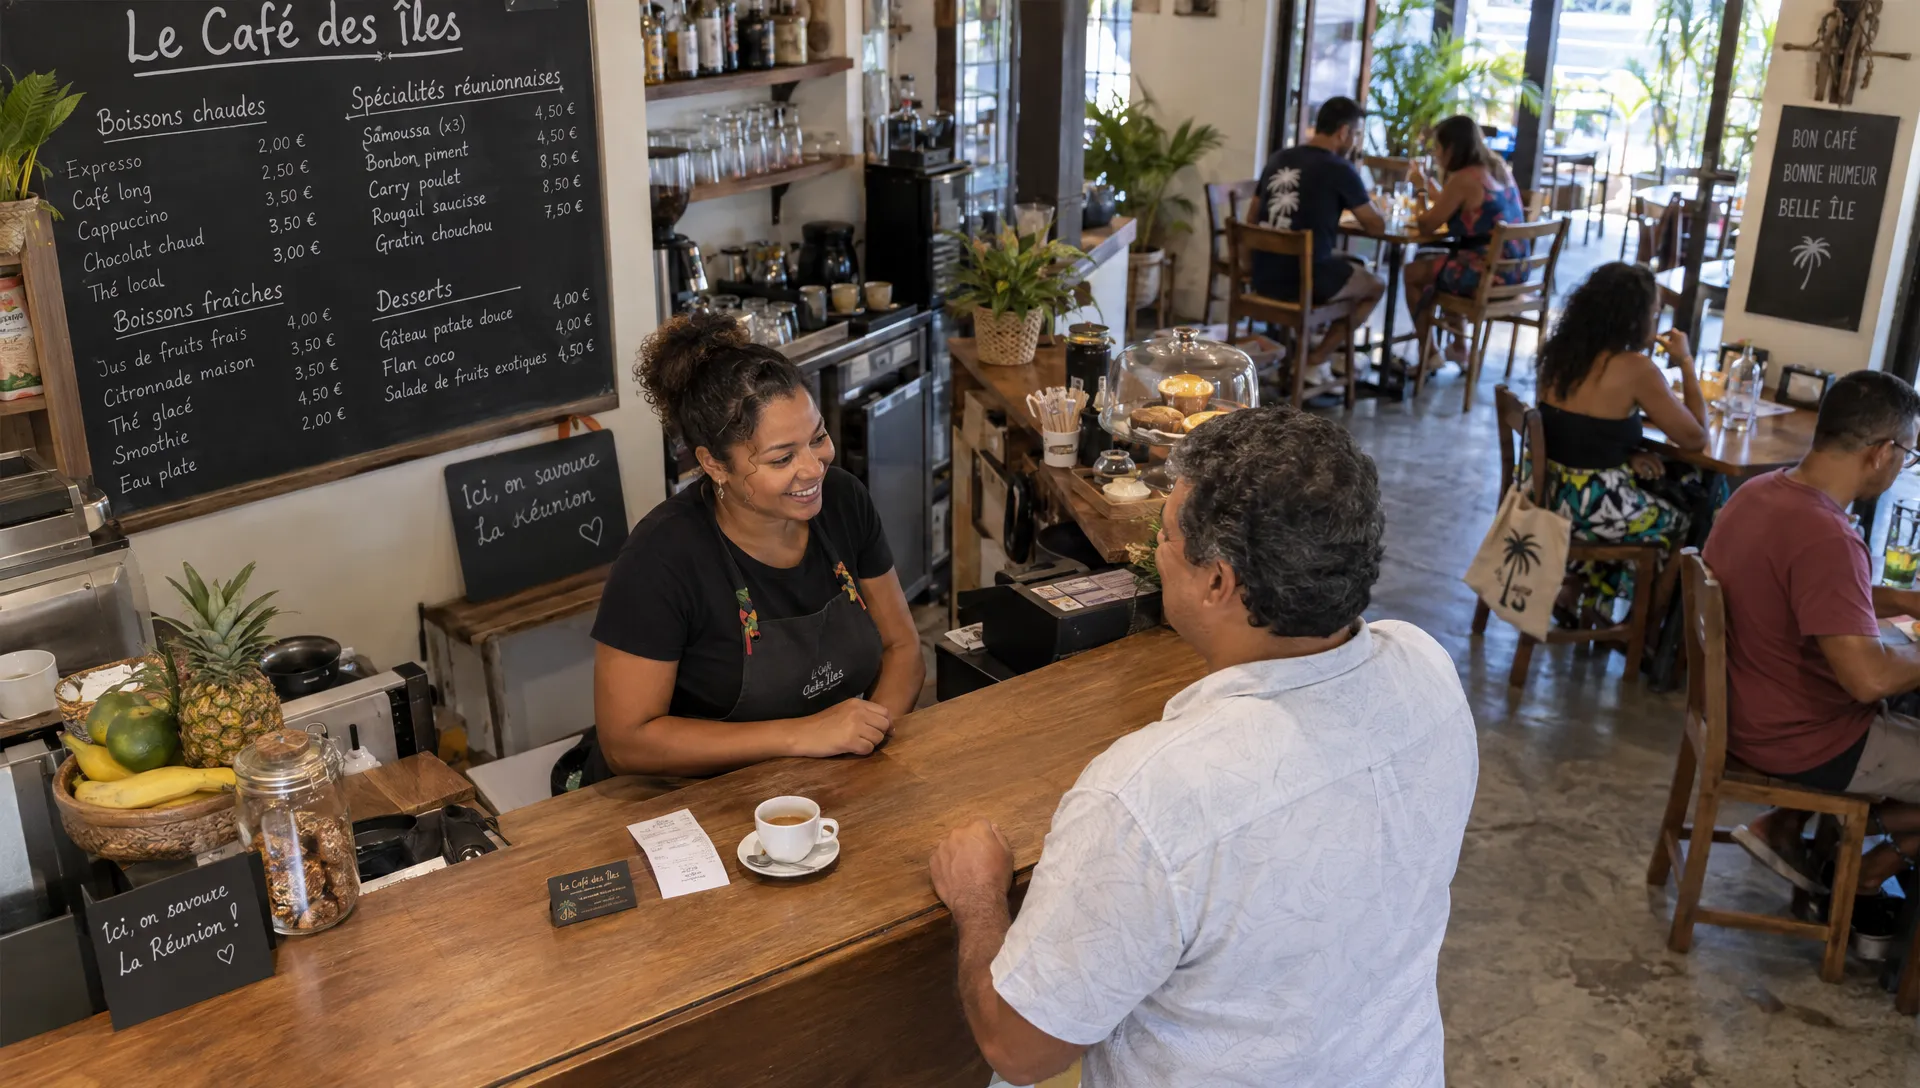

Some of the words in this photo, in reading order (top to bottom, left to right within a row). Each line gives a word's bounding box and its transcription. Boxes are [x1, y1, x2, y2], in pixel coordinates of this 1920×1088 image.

[127, 9, 183, 63] Le
[202, 1, 299, 56] Café
[318, 0, 376, 46] des
[393, 0, 460, 46] Îles
[352, 80, 444, 116] Spécialités
[455, 69, 560, 96] réunionnaises
[97, 108, 182, 136] Boissons
[194, 94, 265, 122] chaudes
[535, 104, 562, 120] 4,50
[567, 102, 575, 114] €
[440, 115, 465, 136] (x3)
[538, 129, 564, 145] 4,50
[569, 126, 577, 139] €
[1792, 129, 1818, 148] BON
[1824, 127, 1857, 149] CAFÉ
[259, 137, 290, 153] 2,00
[296, 134, 305, 147] €
[366, 151, 420, 171] Bonbon
[425, 141, 468, 168] piment
[66, 158, 141, 182] Expresso
[262, 163, 293, 180] 2,50
[300, 160, 309, 173] €
[540, 153, 566, 168] 8,50
[571, 151, 579, 162] €
[369, 180, 409, 200] Carry
[420, 168, 461, 196] poulet
[543, 177, 568, 192] 8,50
[573, 175, 581, 187] €
[1783, 164, 1824, 183] BONNE
[1829, 165, 1877, 185] HUMEUR
[73, 186, 110, 210] Café
[119, 183, 151, 203] long
[266, 189, 297, 206] 3,50
[303, 186, 312, 199] €
[1778, 198, 1820, 218] BELLE
[1828, 196, 1856, 220] ÎLE
[372, 200, 424, 227] Rougail
[433, 194, 486, 213] saucisse
[545, 202, 570, 219] 7,50
[575, 200, 583, 212] €
[79, 212, 168, 243] Cappuccino
[269, 216, 300, 234] 3,50
[307, 212, 316, 226] €
[84, 240, 151, 272] Chocolat
[159, 227, 204, 253] chaud
[376, 231, 424, 254] Gratin
[432, 219, 492, 241] chouchou
[274, 245, 304, 263] 3,00
[311, 241, 320, 254] €
[88, 280, 118, 302] Thé
[128, 269, 165, 293] local
[377, 278, 452, 312] Desserts
[553, 292, 578, 309] 4,00
[582, 288, 589, 300] €
[114, 304, 193, 333] Boissons
[202, 283, 284, 314] fraîches
[288, 312, 317, 329] 4,00
[323, 308, 331, 321] €
[380, 329, 427, 350] Gâteau
[434, 315, 473, 342] patate
[480, 309, 512, 325] douce
[556, 317, 580, 335] 4,00
[584, 313, 592, 326] €
[97, 360, 126, 377] Jus
[135, 350, 152, 366] de
[159, 337, 203, 362] fruits
[211, 327, 246, 348] frais
[292, 337, 320, 355] 3,50
[327, 333, 335, 346] €
[558, 343, 583, 363] 4,50
[586, 339, 594, 351] €
[295, 362, 324, 380] 3,50
[330, 358, 338, 370] €
[383, 357, 416, 376] Flan
[425, 351, 454, 366] coco
[104, 369, 192, 407] Citronnade
[201, 358, 254, 380] maison
[385, 379, 427, 402] Salade
[435, 374, 448, 389] de
[455, 364, 488, 386] fruits
[496, 353, 546, 374] exotiques
[299, 387, 328, 405] 4,50
[334, 382, 342, 395] €
[108, 412, 140, 435] Thé
[153, 396, 193, 430] glacé
[302, 412, 331, 430] 2,00
[337, 407, 346, 419] €
[113, 432, 189, 465] Smoothie
[120, 474, 151, 494] Eau
[159, 458, 197, 488] plate
[462, 479, 498, 509] Ici,
[505, 478, 525, 493] on
[535, 454, 599, 485] savoure
[475, 516, 504, 546] La
[102, 918, 133, 943] Ici,
[140, 914, 159, 928] on
[168, 886, 228, 918] savoure
[120, 951, 142, 976] La
[150, 921, 226, 961] Réunion
[230, 902, 238, 927] !
